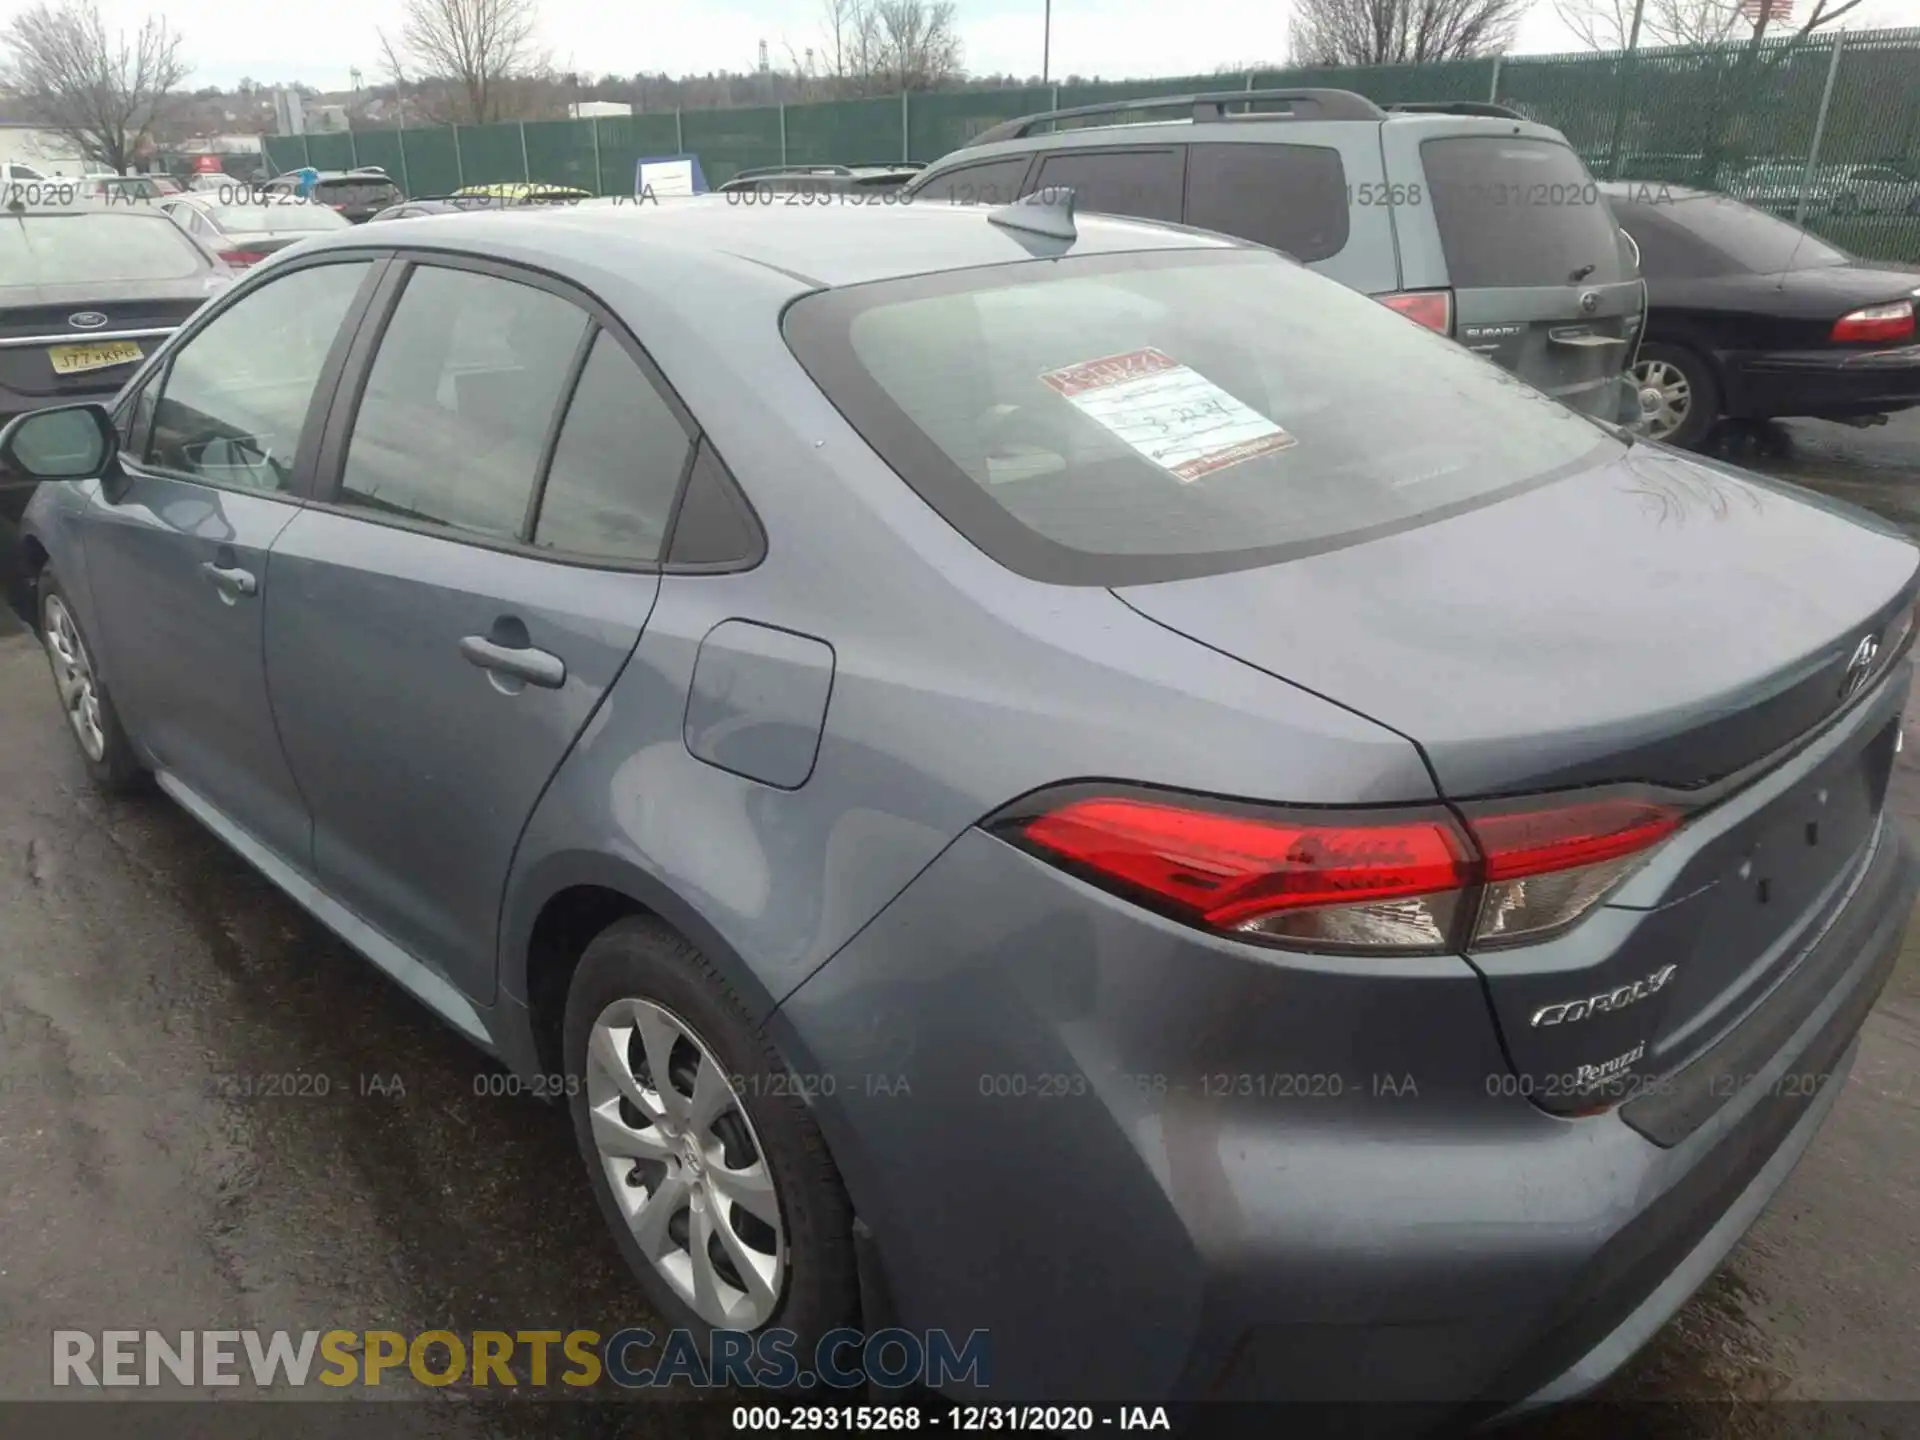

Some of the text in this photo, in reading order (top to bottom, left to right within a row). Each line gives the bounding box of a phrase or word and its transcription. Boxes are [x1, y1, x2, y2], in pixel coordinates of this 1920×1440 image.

[1465, 326, 1521, 337] SUBARU
[1531, 964, 1677, 1027] COROLLA
[1575, 1040, 1646, 1086] Peruzzi
